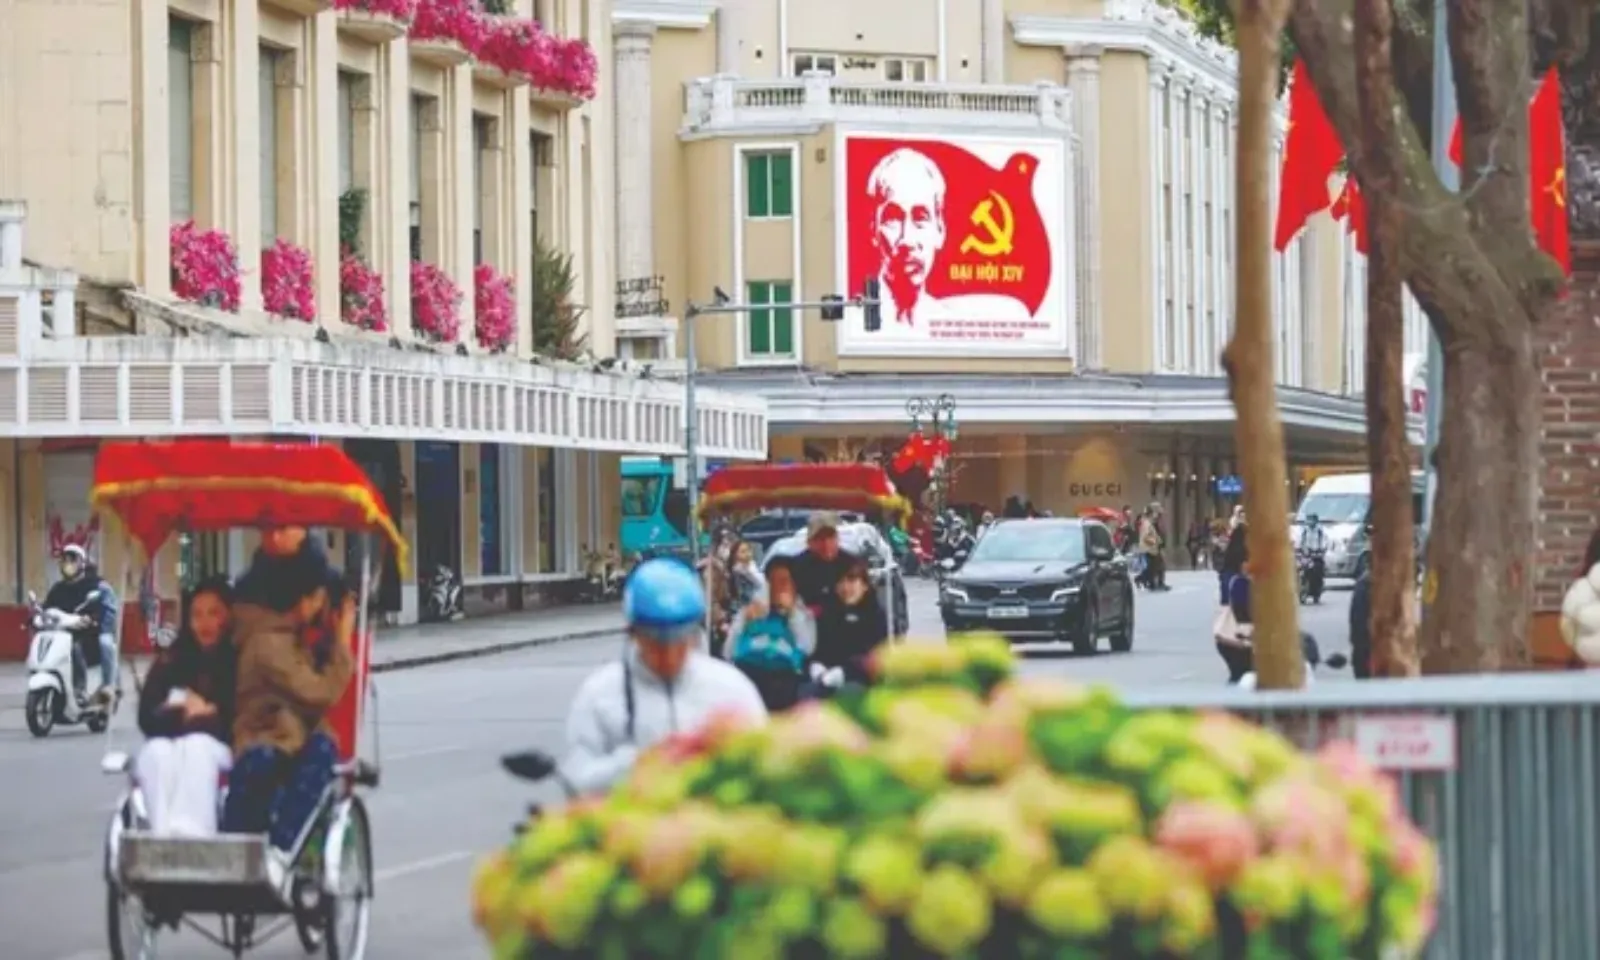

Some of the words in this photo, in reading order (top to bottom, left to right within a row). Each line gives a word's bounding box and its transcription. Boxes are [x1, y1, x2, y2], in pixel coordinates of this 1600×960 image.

[950, 264, 973, 284] ĐẠI
[976, 261, 999, 284] HỘI
[1002, 264, 1024, 282] XIV
[1069, 482, 1122, 497] GUCCI
